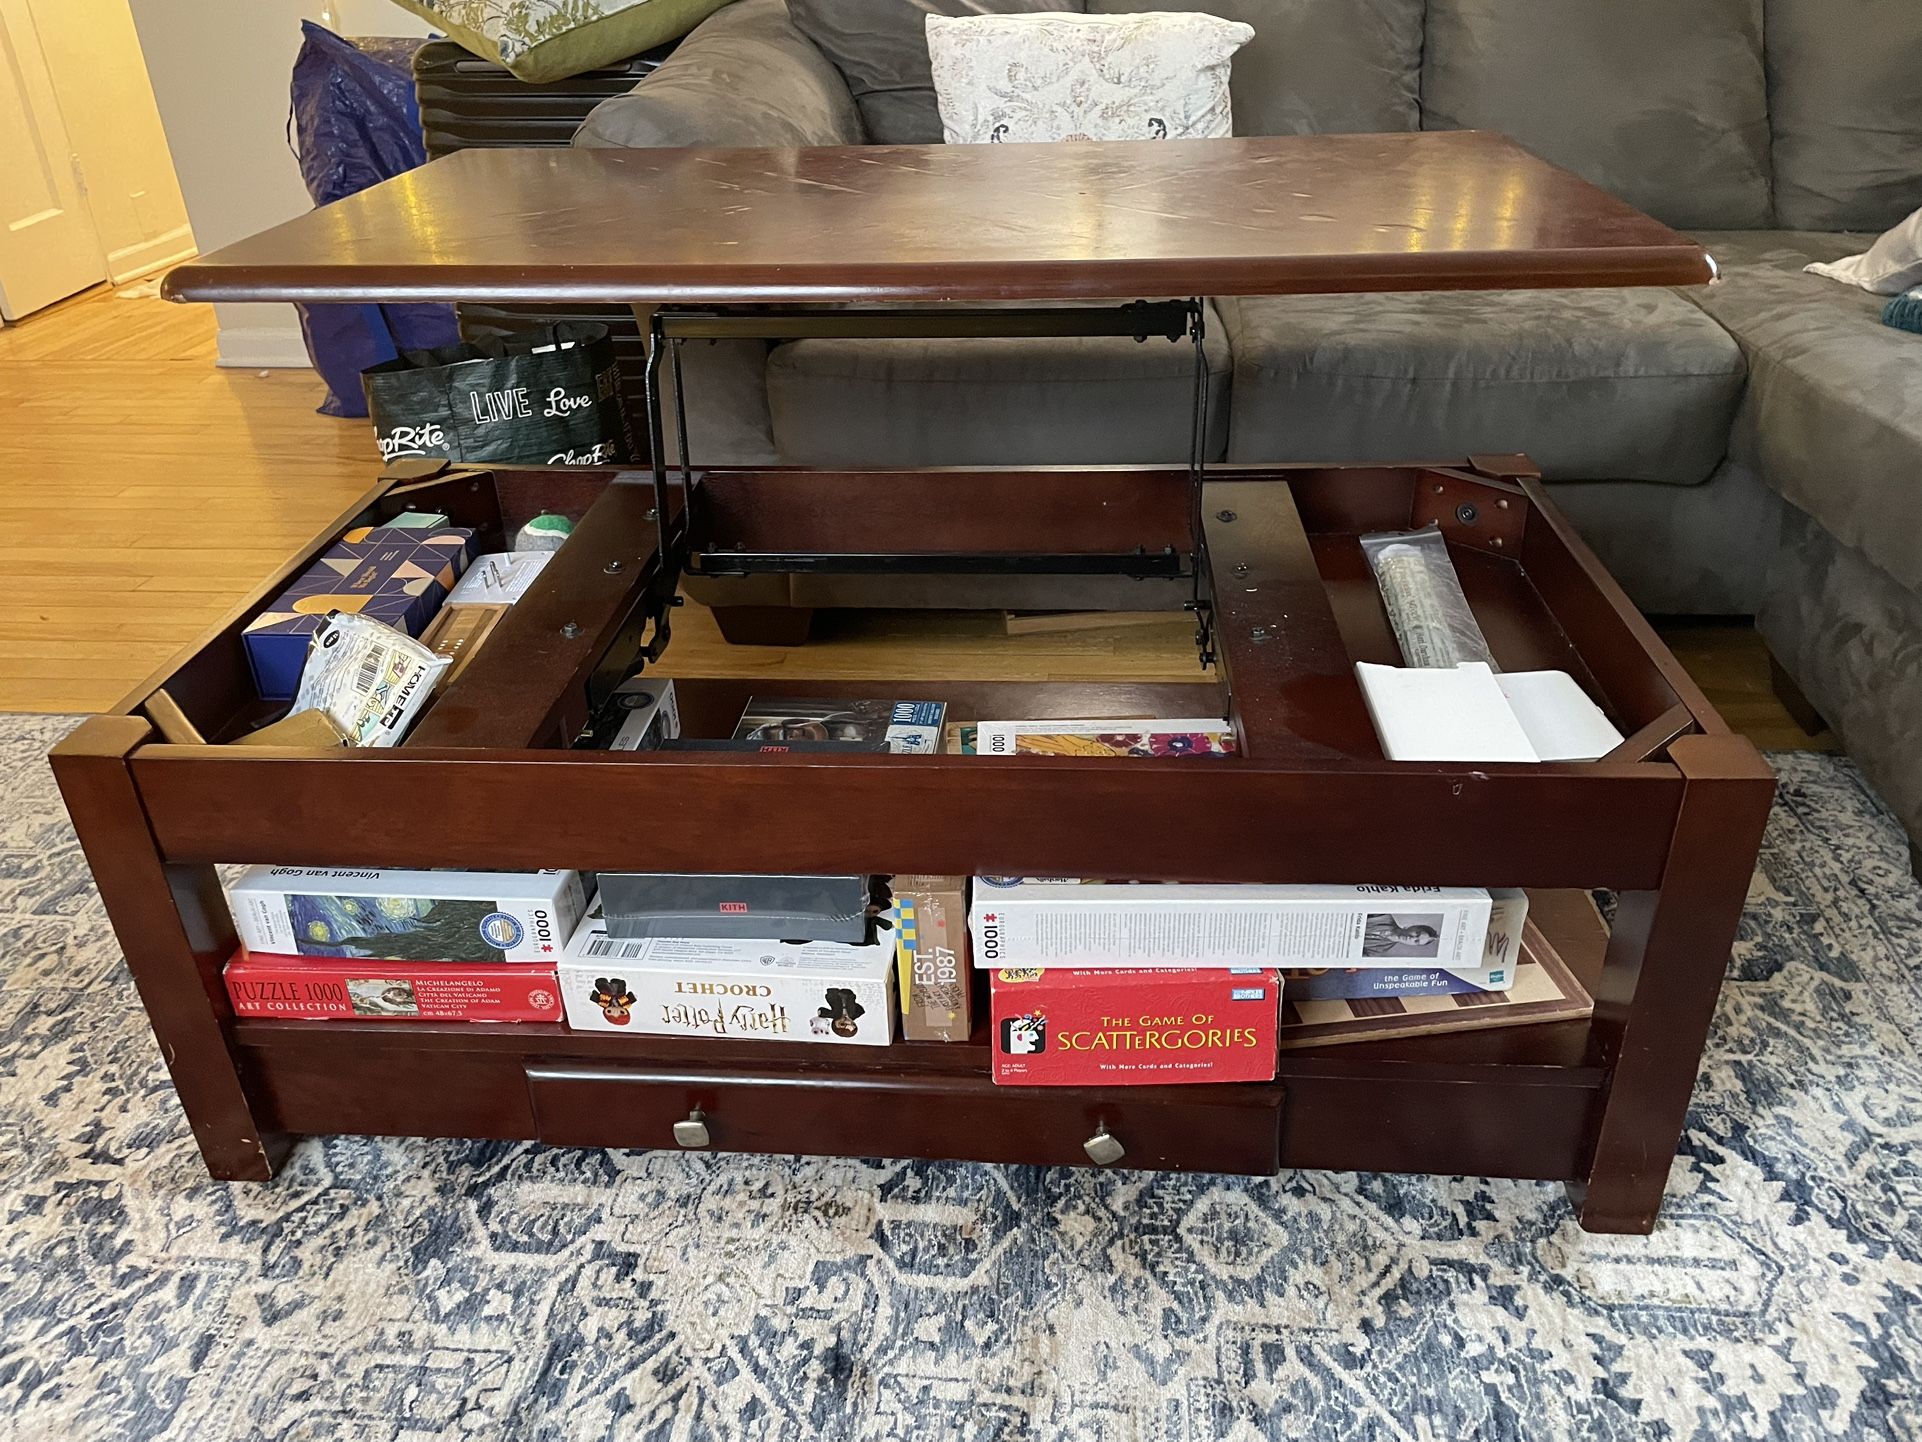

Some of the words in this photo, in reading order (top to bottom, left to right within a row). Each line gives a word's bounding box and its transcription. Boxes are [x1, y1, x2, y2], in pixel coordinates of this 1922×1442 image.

[470, 387, 532, 425] LIVE
[543, 387, 592, 417] Love
[396, 665, 425, 706] HOME
[893, 702, 915, 722] 1000
[992, 734, 1005, 752] 1000
[270, 867, 303, 876] Gogh
[306, 869, 329, 877] van
[332, 871, 380, 880] Vincent
[1356, 885, 1399, 893] Kahlo
[720, 903, 747, 912] KITH
[534, 909, 552, 942] 1000
[983, 925, 998, 959] 1000
[913, 948, 935, 985] EST.
[935, 946, 957, 985] 1987
[1093, 968, 1114, 976] More
[1116, 968, 1137, 976] Cards
[1139, 967, 1153, 975] and
[1373, 980, 1429, 990] Unspeakable
[1431, 979, 1448, 987] Fun
[1384, 974, 1400, 982] the
[1402, 973, 1428, 982] Game
[1429, 972, 1439, 980] of
[232, 981, 300, 1001] PUZZLE
[304, 983, 343, 1002] 1000
[674, 982, 772, 998] CROCHET
[239, 1002, 261, 1011] ART
[266, 1003, 347, 1012] COLLECTION
[661, 997, 728, 1034] Potter
[729, 1003, 790, 1034] Harry
[1100, 1017, 1132, 1027] THE
[1139, 1015, 1184, 1027] GAME
[1192, 1013, 1214, 1025] OF
[1057, 1028, 1258, 1051] SCATTERGORIES
[1100, 1063, 1119, 1071] With
[1120, 1063, 1137, 1071] More
[1158, 1062, 1173, 1070] and
[1174, 1062, 1213, 1070] Categories!
